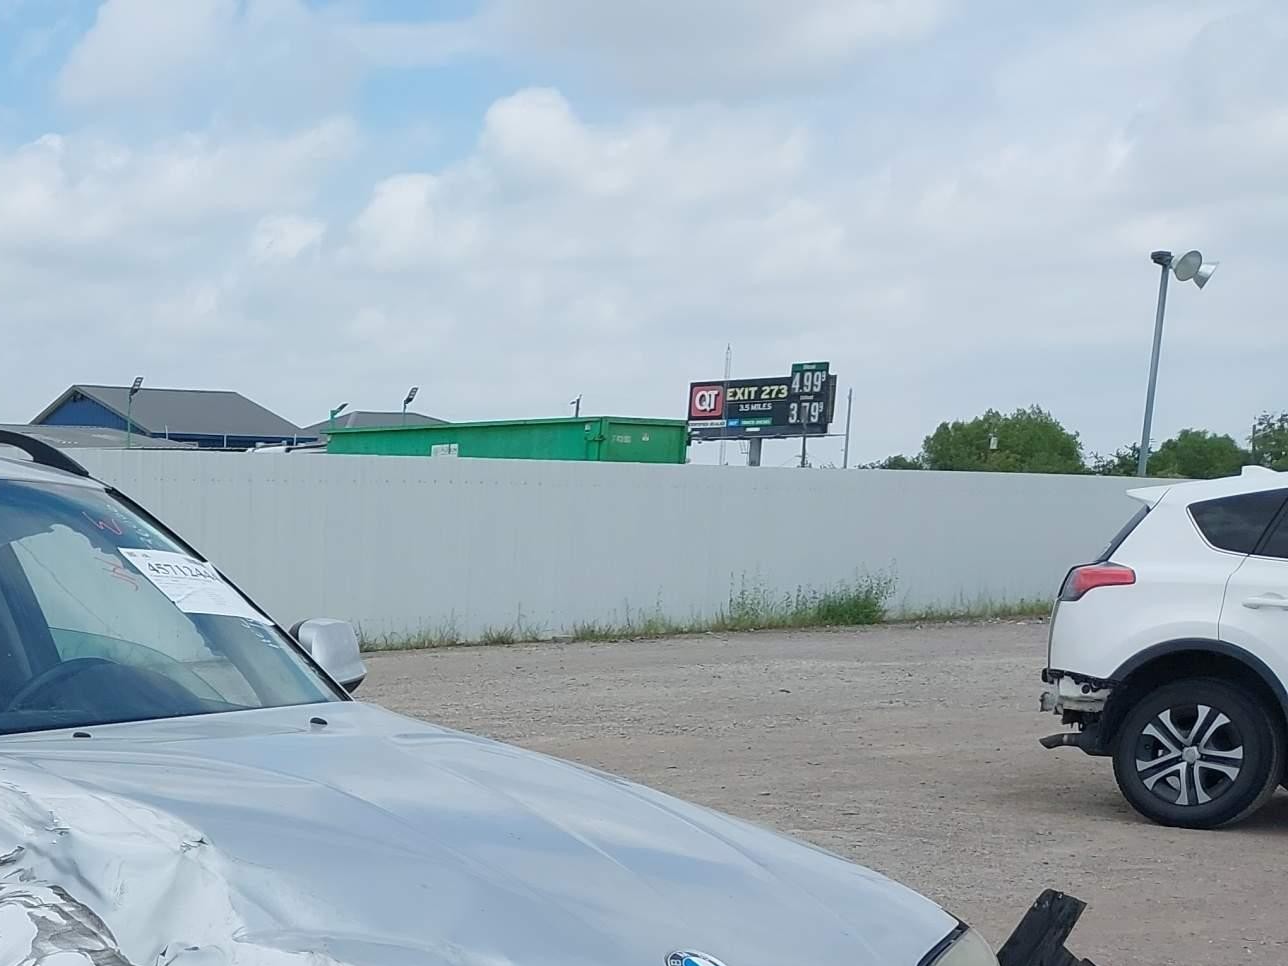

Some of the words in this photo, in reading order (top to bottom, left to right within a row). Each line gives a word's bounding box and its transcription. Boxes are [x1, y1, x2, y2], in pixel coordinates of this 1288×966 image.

[726, 387, 758, 401] EXIT
[761, 384, 788, 399] 273
[695, 390, 719, 413] QT
[751, 402, 773, 411] MILES
